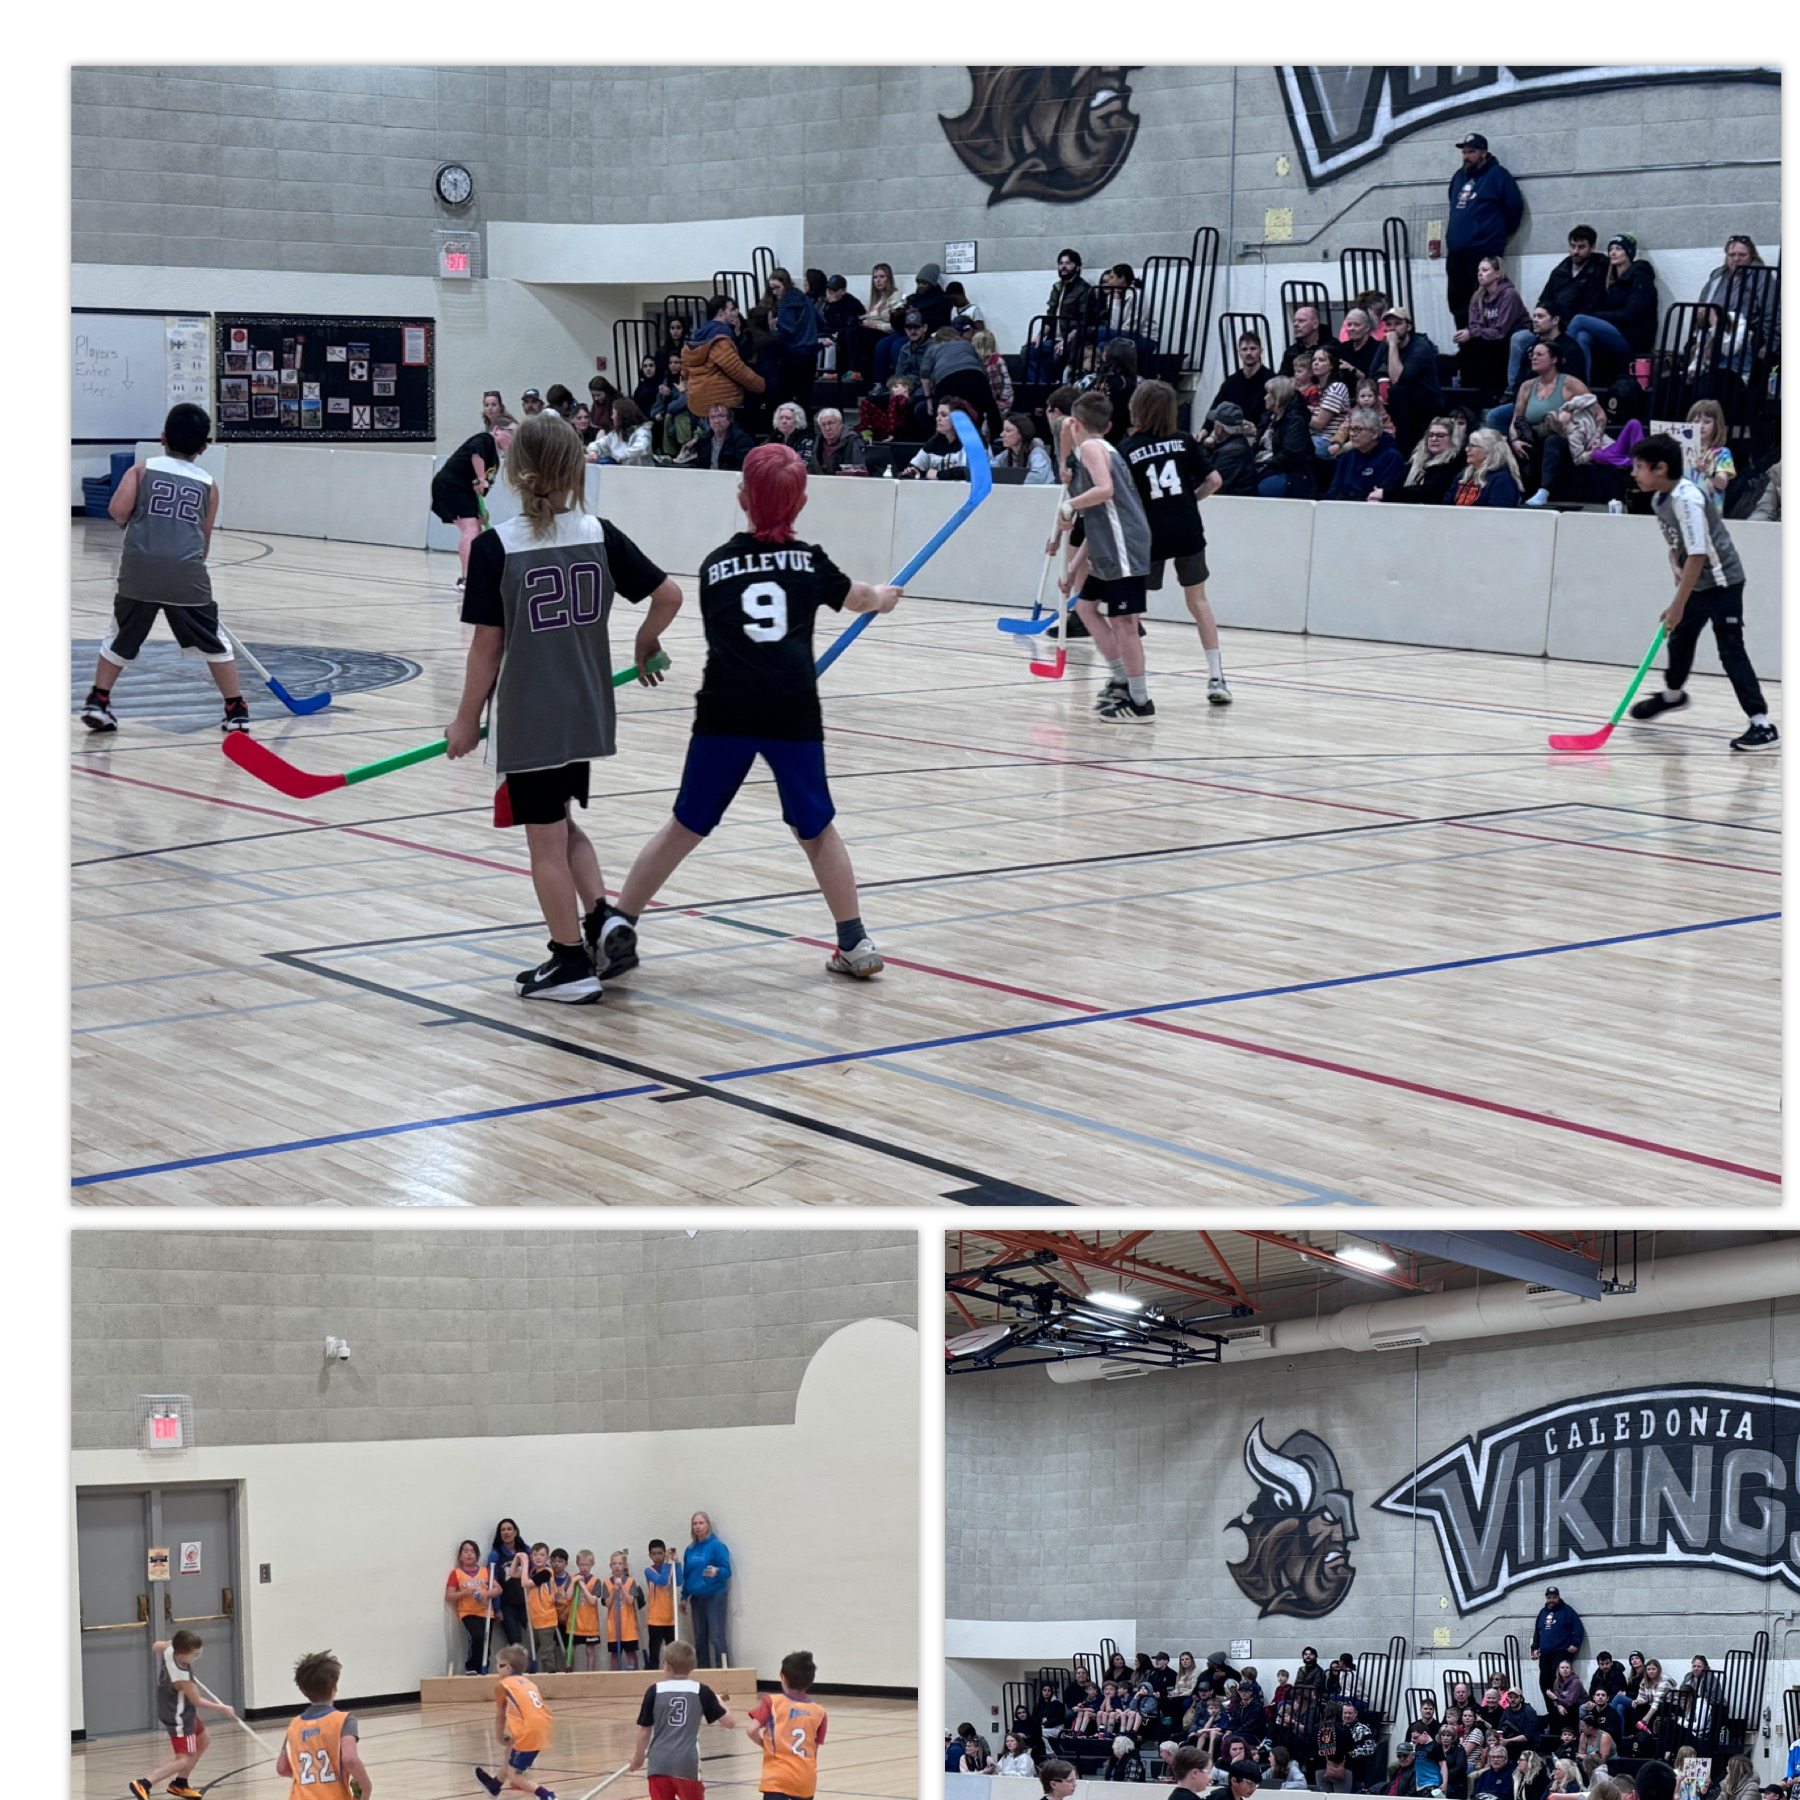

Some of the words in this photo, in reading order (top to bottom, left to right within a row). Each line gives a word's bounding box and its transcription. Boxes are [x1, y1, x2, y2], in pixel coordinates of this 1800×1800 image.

[75, 335, 118, 363] Players
[1129, 439, 1186, 464] BELLEVUE
[1146, 459, 1183, 500] 14
[148, 480, 202, 523] 22
[708, 550, 816, 586] BELLEVUE
[525, 562, 602, 632] 20
[741, 581, 788, 643] 9
[154, 1419, 177, 1439] EXIT
[1545, 1406, 1754, 1456] CALEDONIA
[667, 1696, 687, 1728] 3
[790, 1727, 807, 1758] 2
[298, 1749, 337, 1785] 22
